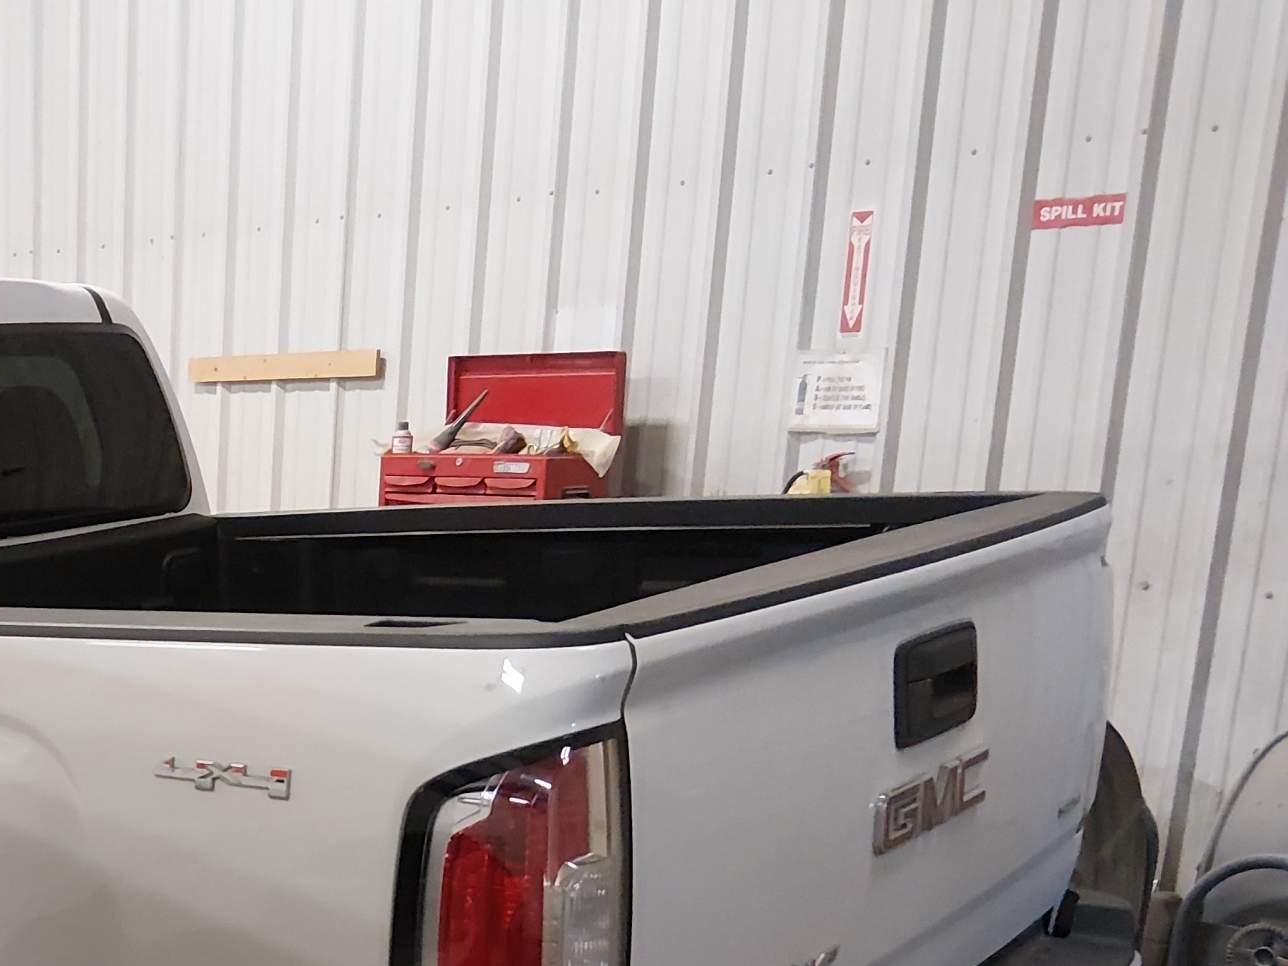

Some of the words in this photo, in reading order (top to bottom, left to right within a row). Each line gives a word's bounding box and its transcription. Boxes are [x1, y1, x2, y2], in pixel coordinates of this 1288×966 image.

[1040, 204, 1087, 222] SPILL
[1092, 201, 1124, 217] KIT
[872, 743, 990, 857] GMC
